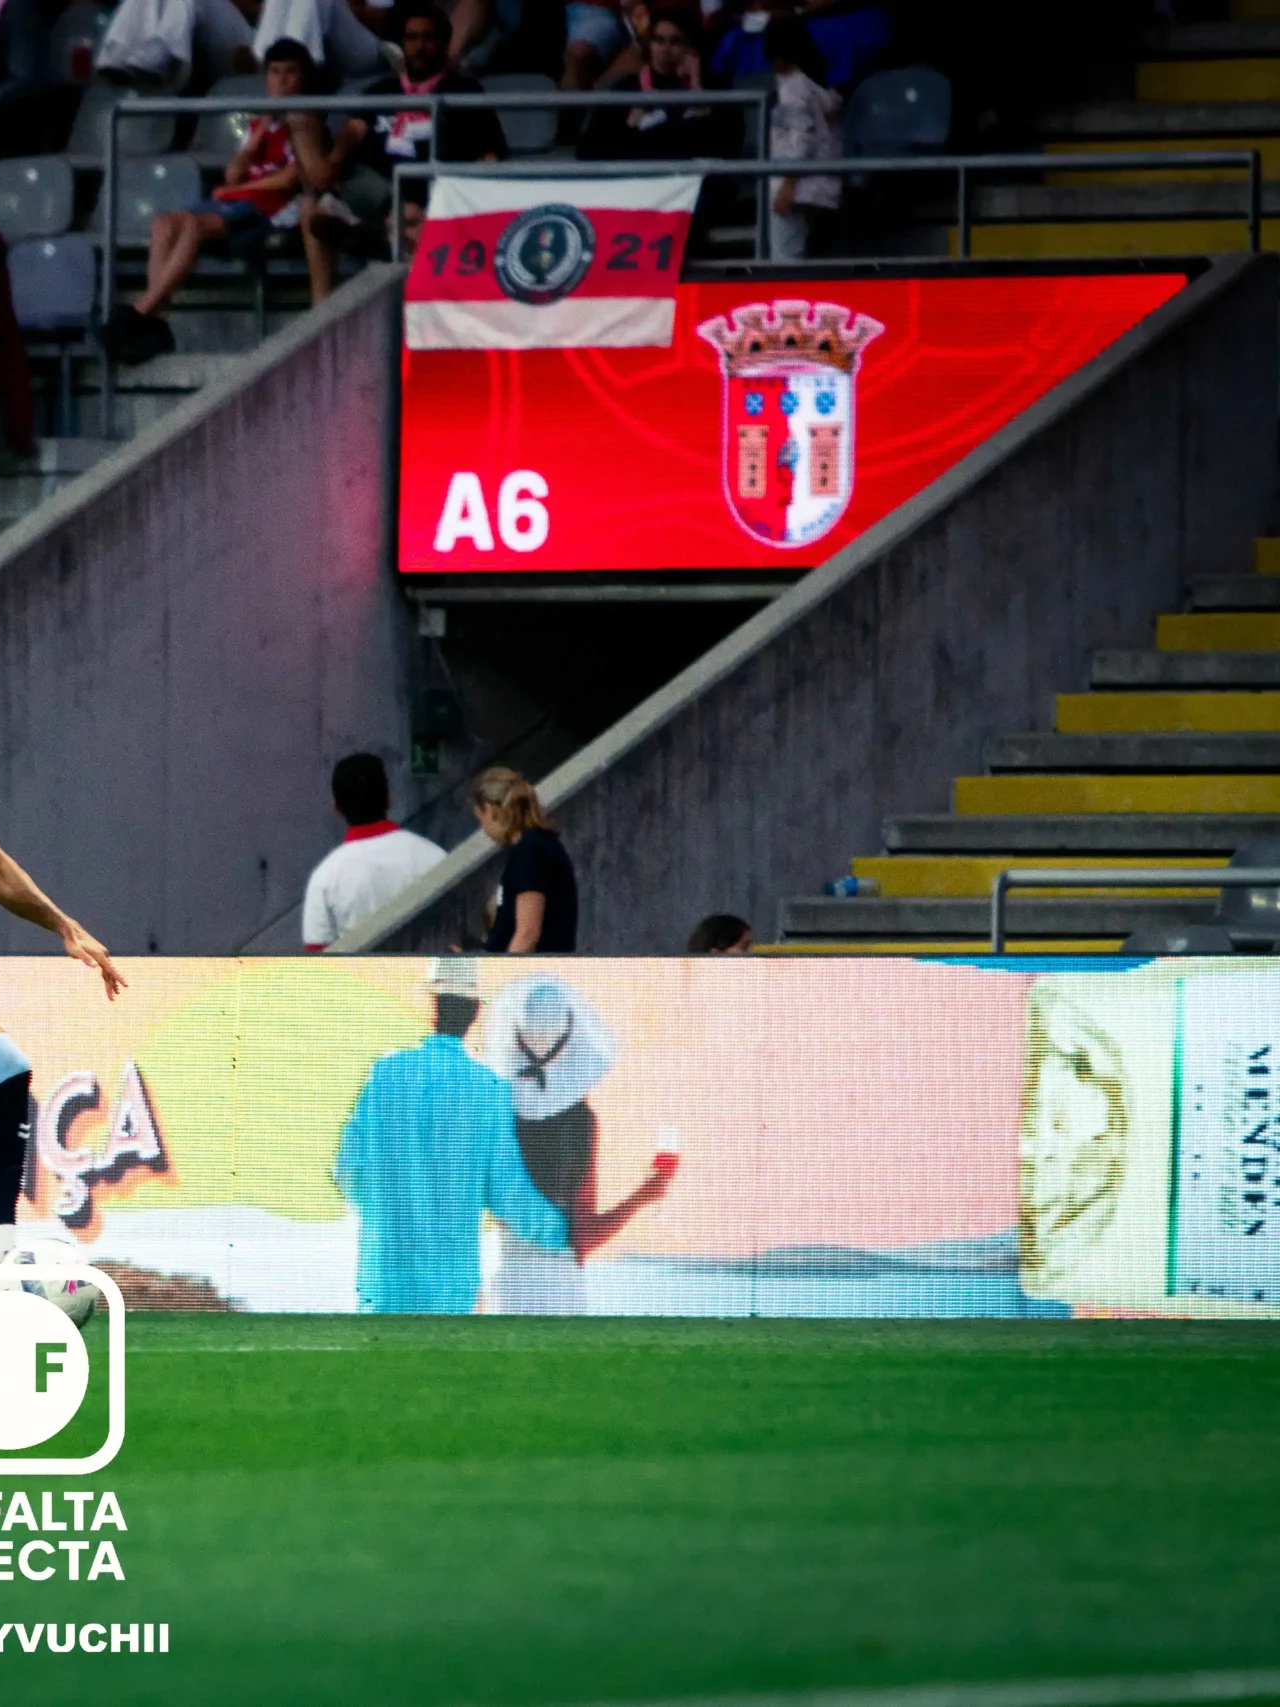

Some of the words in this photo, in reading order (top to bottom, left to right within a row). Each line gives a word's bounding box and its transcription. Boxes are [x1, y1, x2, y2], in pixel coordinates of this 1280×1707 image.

[427, 240, 485, 276] 19
[607, 233, 674, 271] 21
[434, 470, 550, 553] A6
